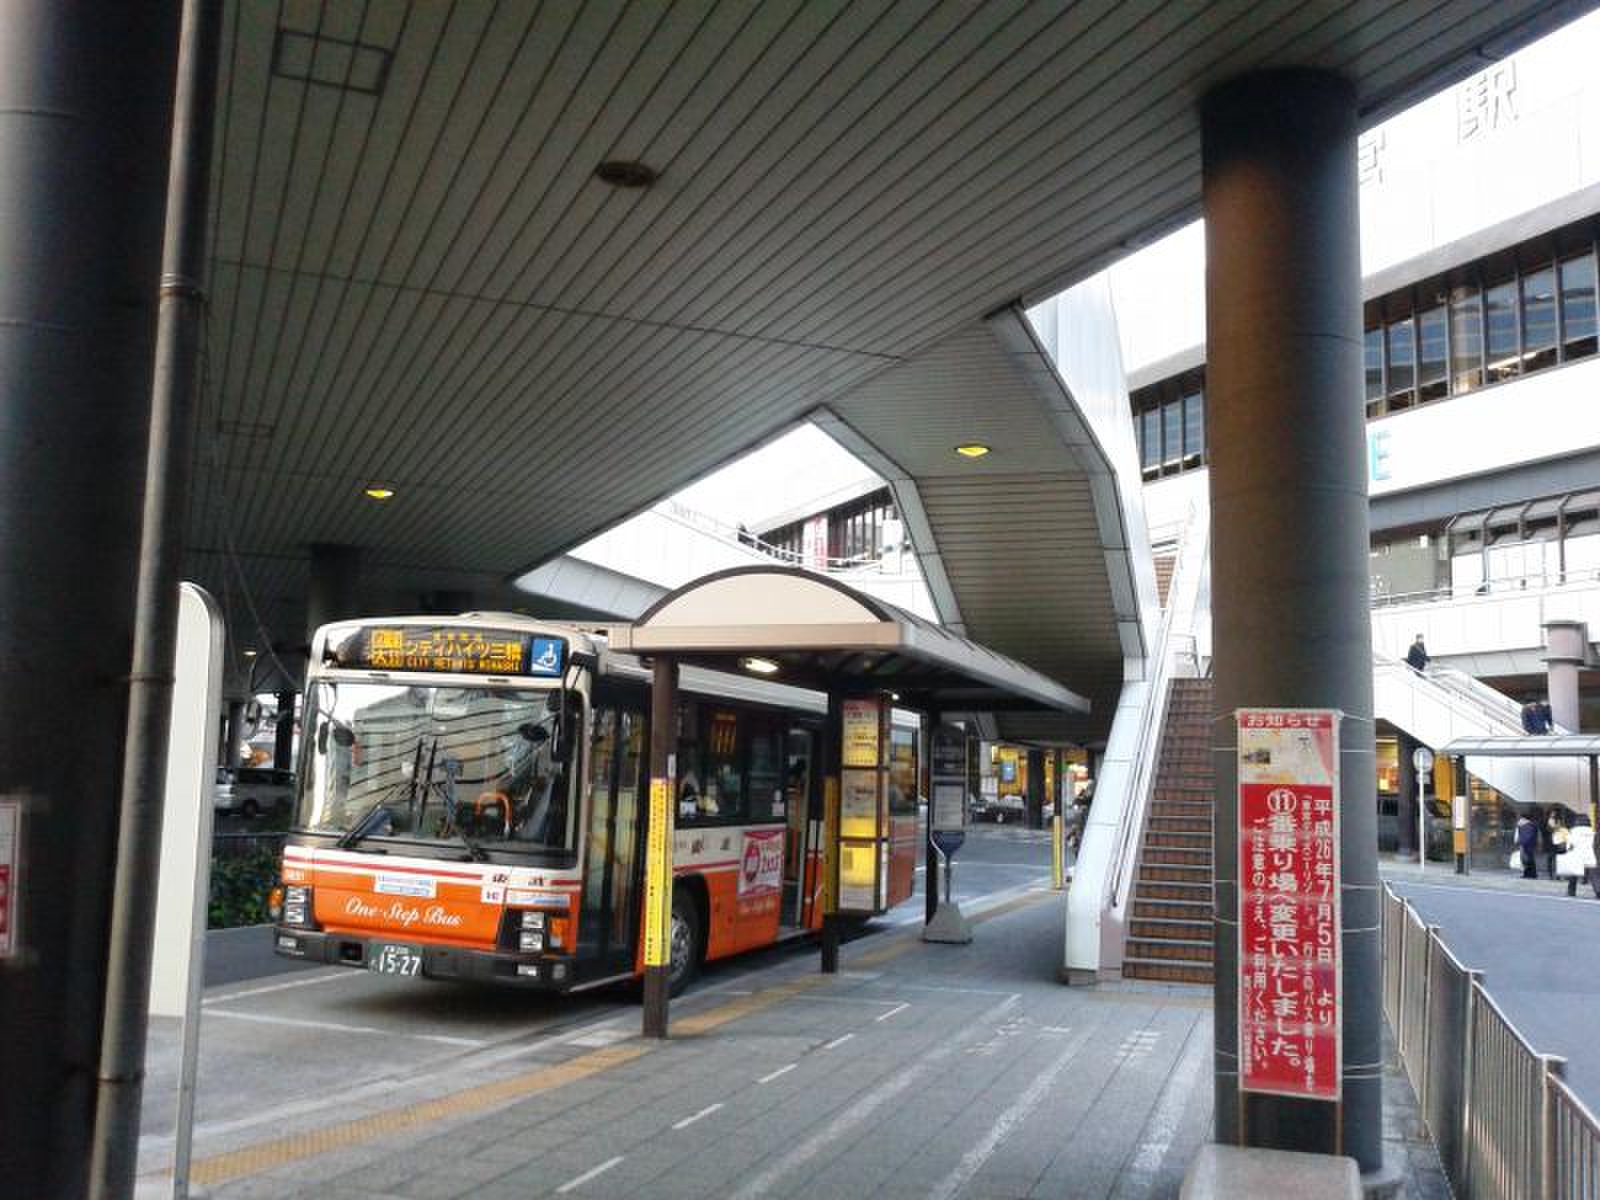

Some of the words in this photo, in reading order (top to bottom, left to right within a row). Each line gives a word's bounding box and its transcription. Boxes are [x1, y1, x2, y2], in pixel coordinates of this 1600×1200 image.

[1247, 714, 1320, 728] お知らせ
[1313, 799, 1333, 962] 平成26年7月5日
[421, 904, 465, 928] Bus
[1317, 988, 1334, 1026] より
